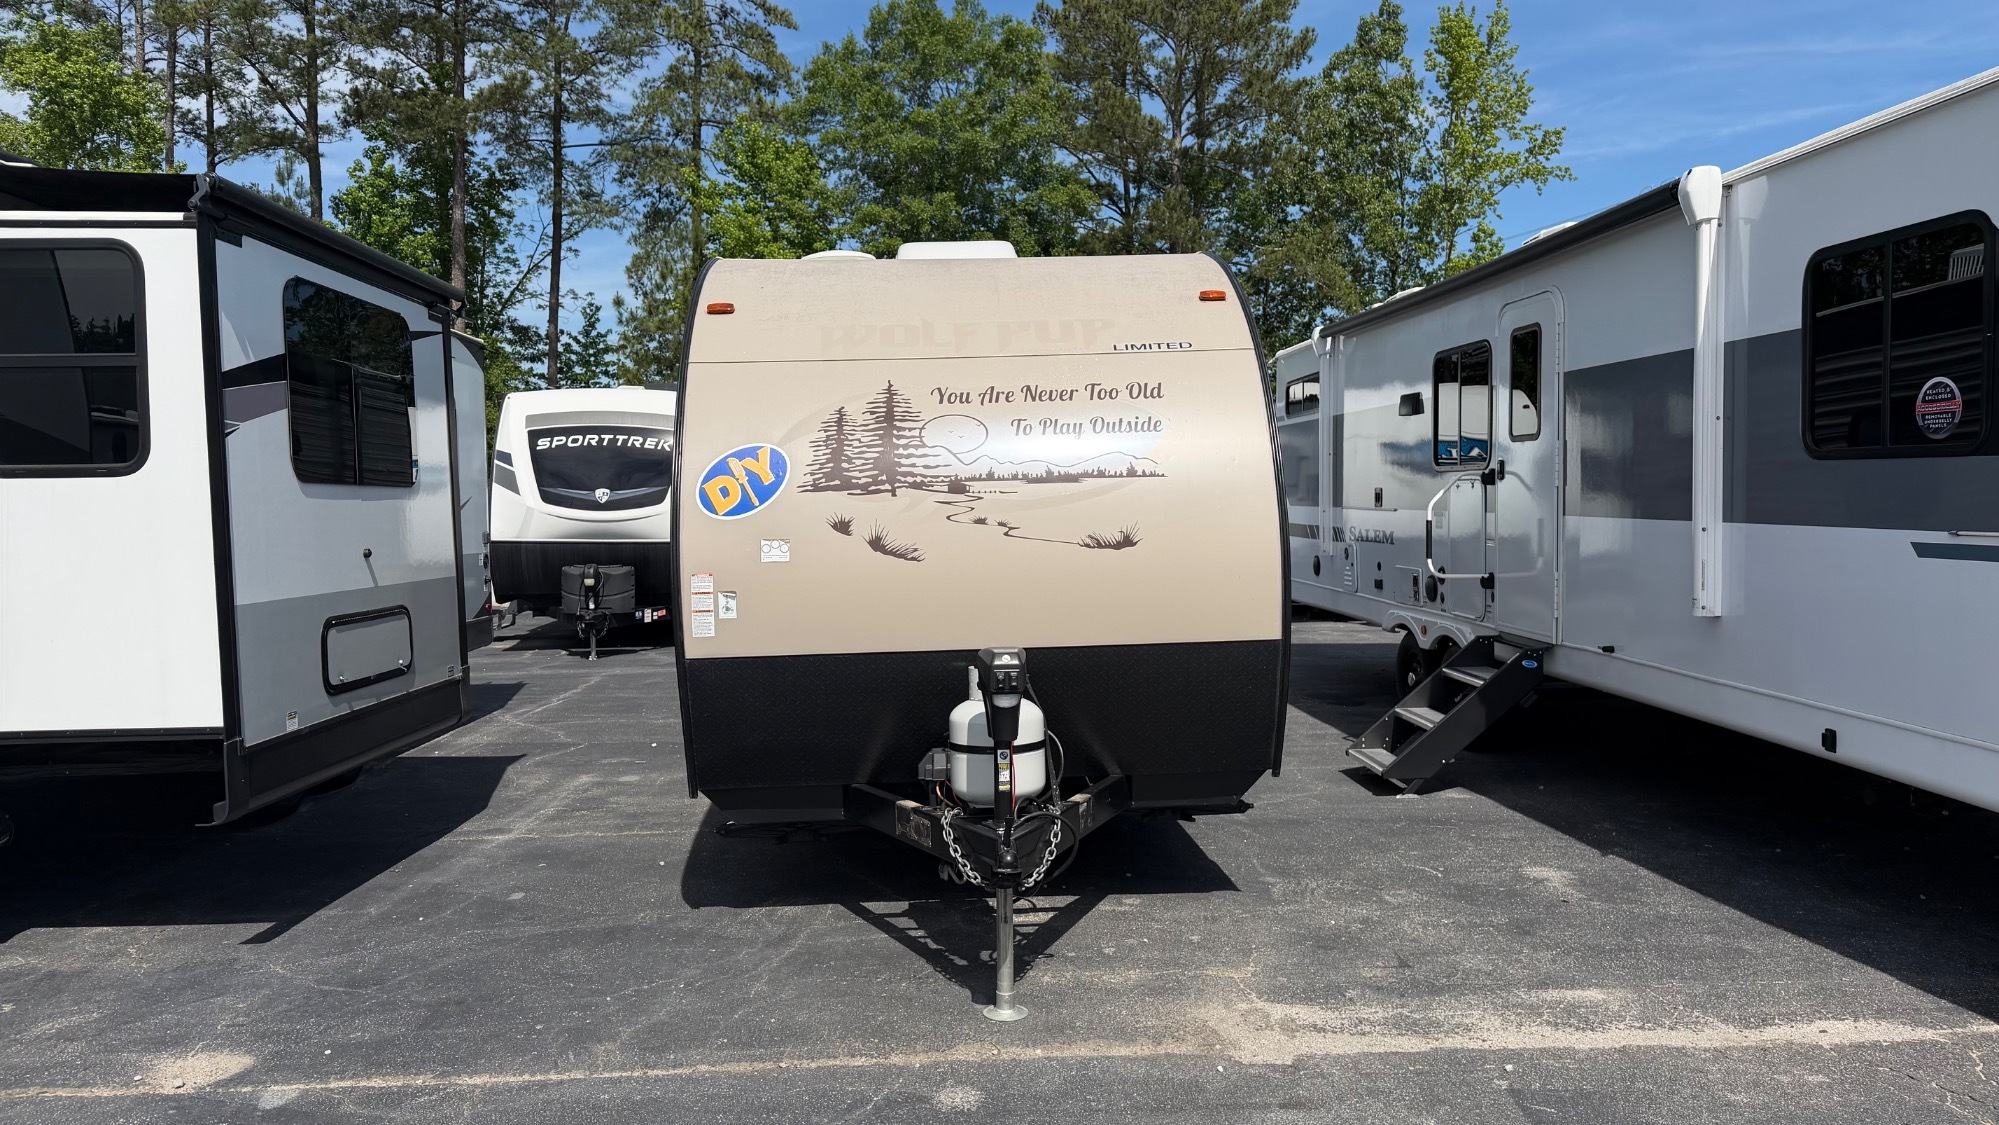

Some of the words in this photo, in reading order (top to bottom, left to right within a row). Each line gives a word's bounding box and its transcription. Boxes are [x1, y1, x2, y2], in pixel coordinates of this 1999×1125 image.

[1112, 341, 1194, 351] LIMITED
[930, 386, 973, 405] You
[978, 385, 1016, 406] Are
[1020, 384, 1079, 403] Never
[1084, 382, 1123, 401] Too
[1125, 381, 1165, 400] Old
[1010, 417, 1036, 437] To
[1038, 416, 1085, 440] Play
[1089, 416, 1164, 435] Outside
[535, 434, 671, 451] SPORTTREK
[1348, 525, 1396, 545] SALEM
